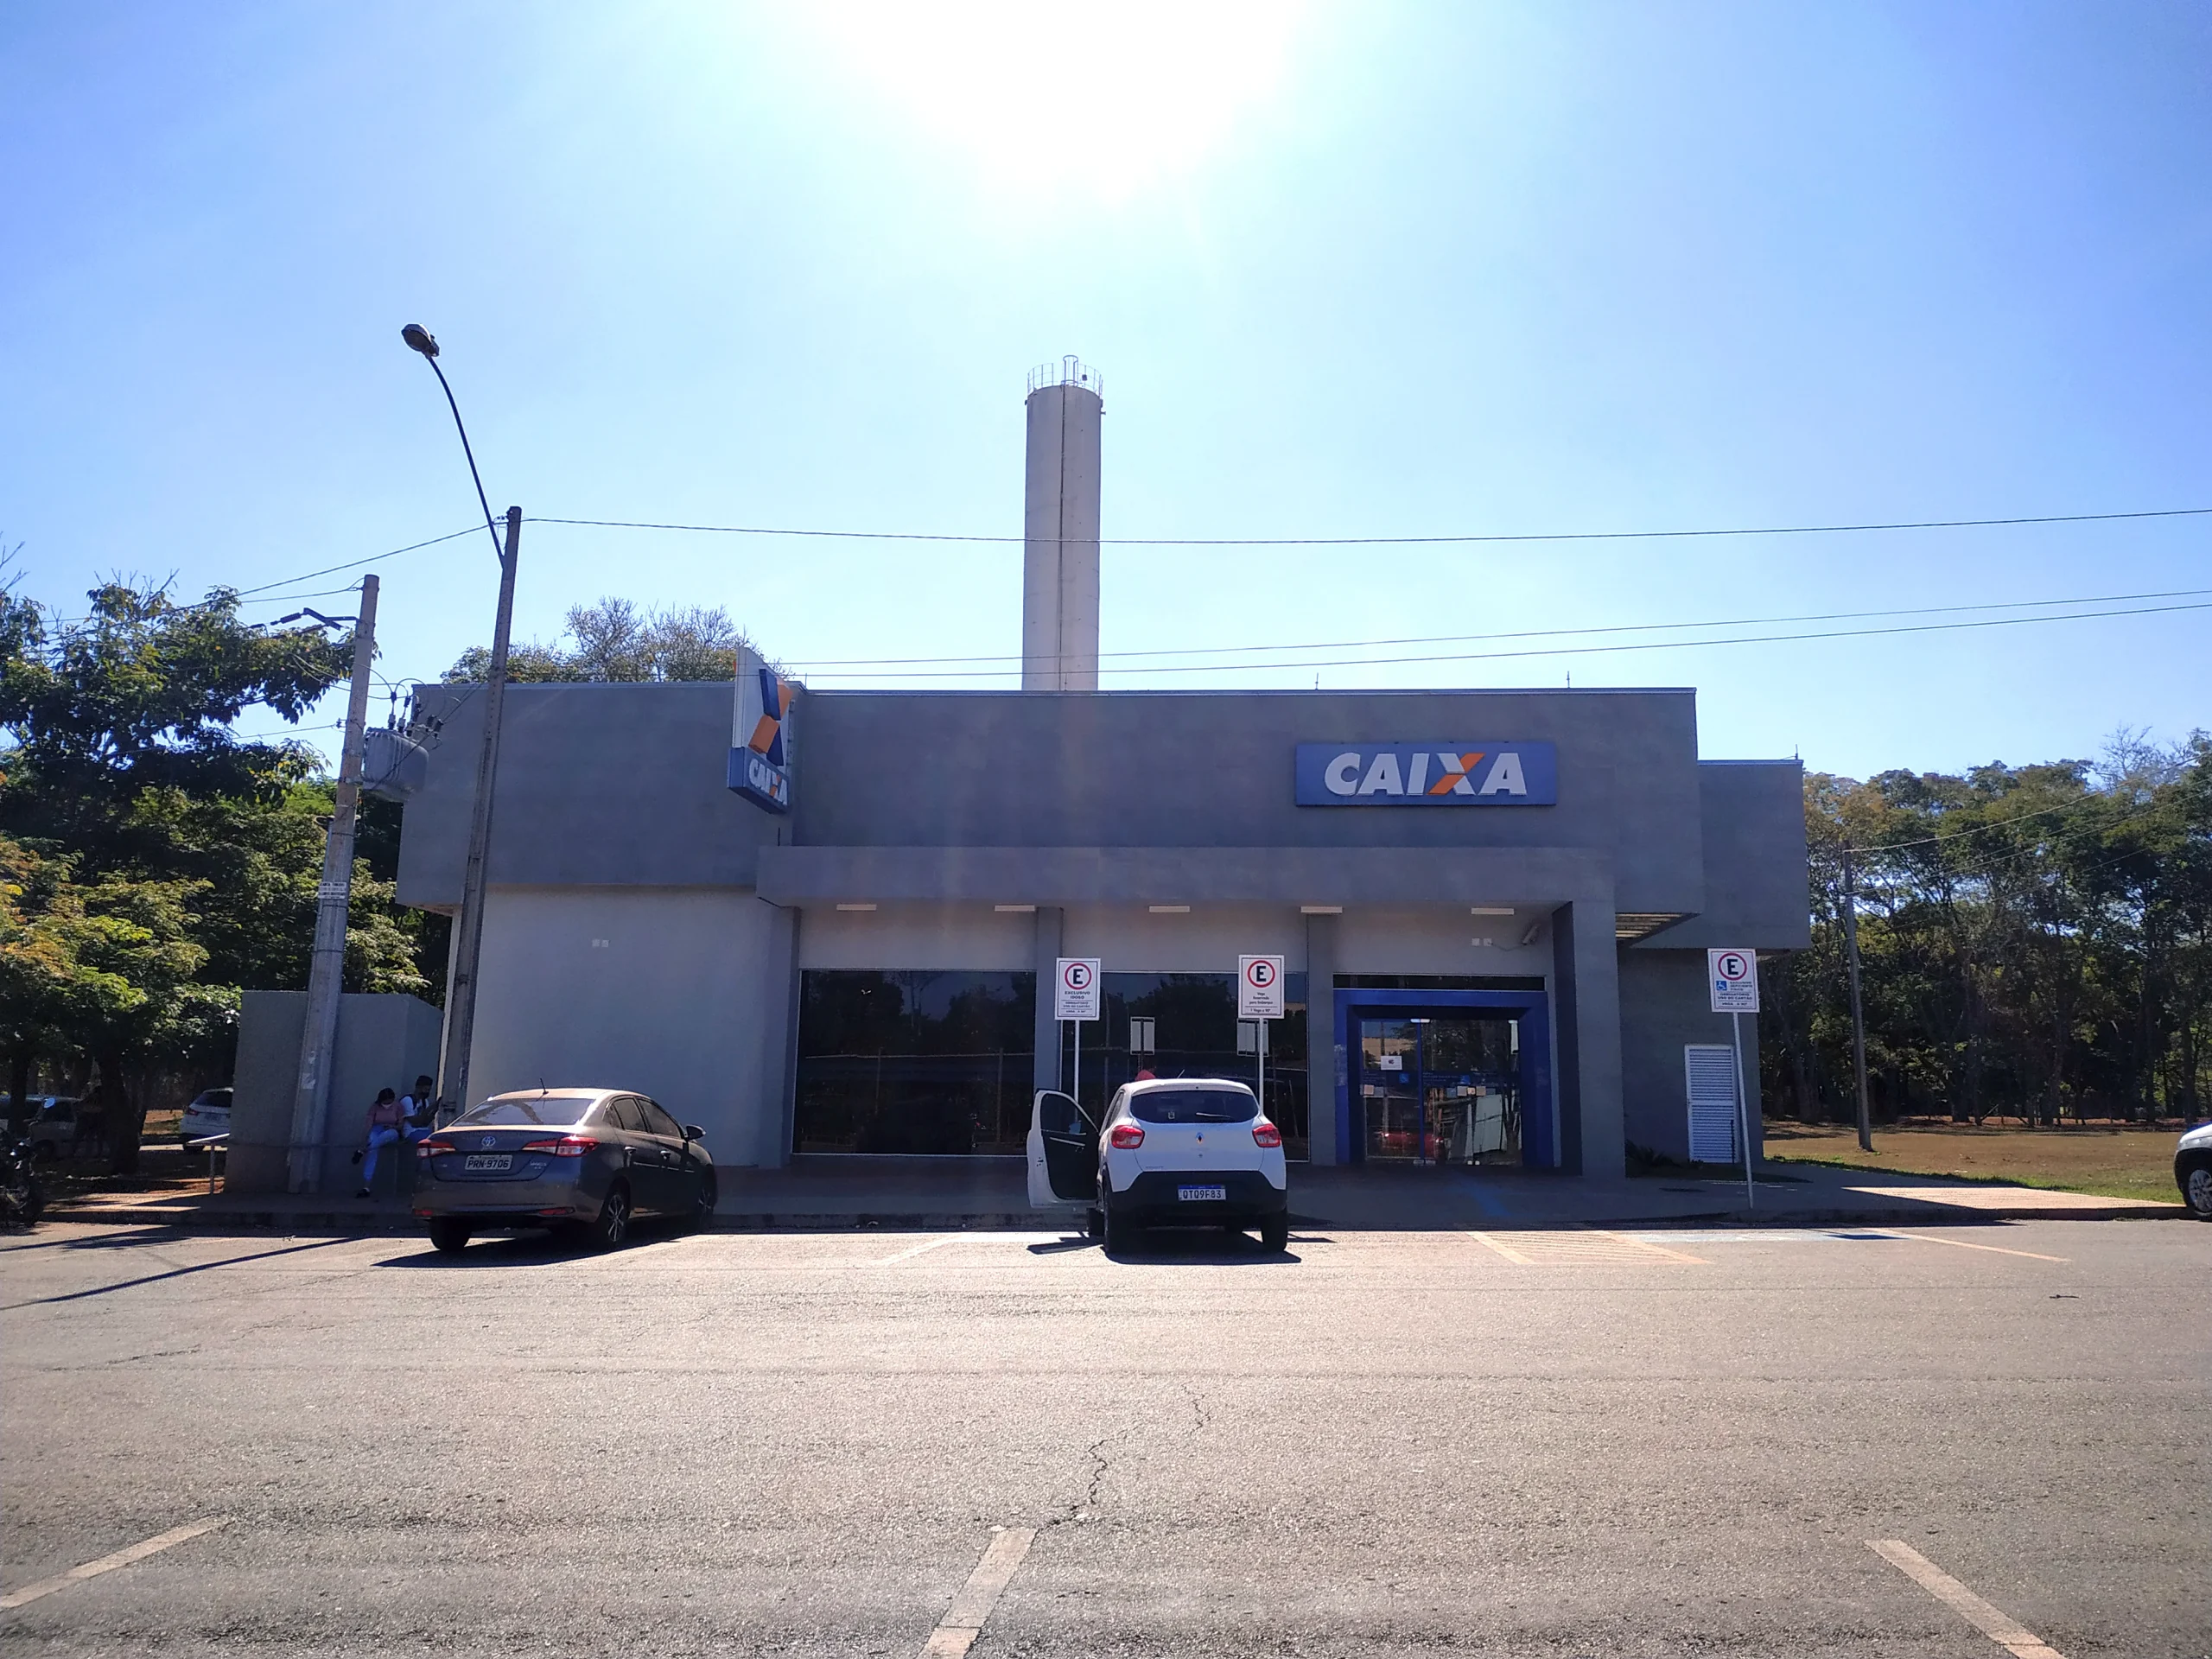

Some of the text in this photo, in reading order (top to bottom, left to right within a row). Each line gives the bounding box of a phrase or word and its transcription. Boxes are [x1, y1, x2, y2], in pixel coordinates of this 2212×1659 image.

[748, 758, 788, 805] CAIXA
[1324, 752, 1528, 796] CAIXA
[1256, 965, 1267, 982] E
[1726, 958, 1738, 976] E
[1073, 969, 1084, 984] E
[1183, 1190, 1222, 1198] QTQ9F83
